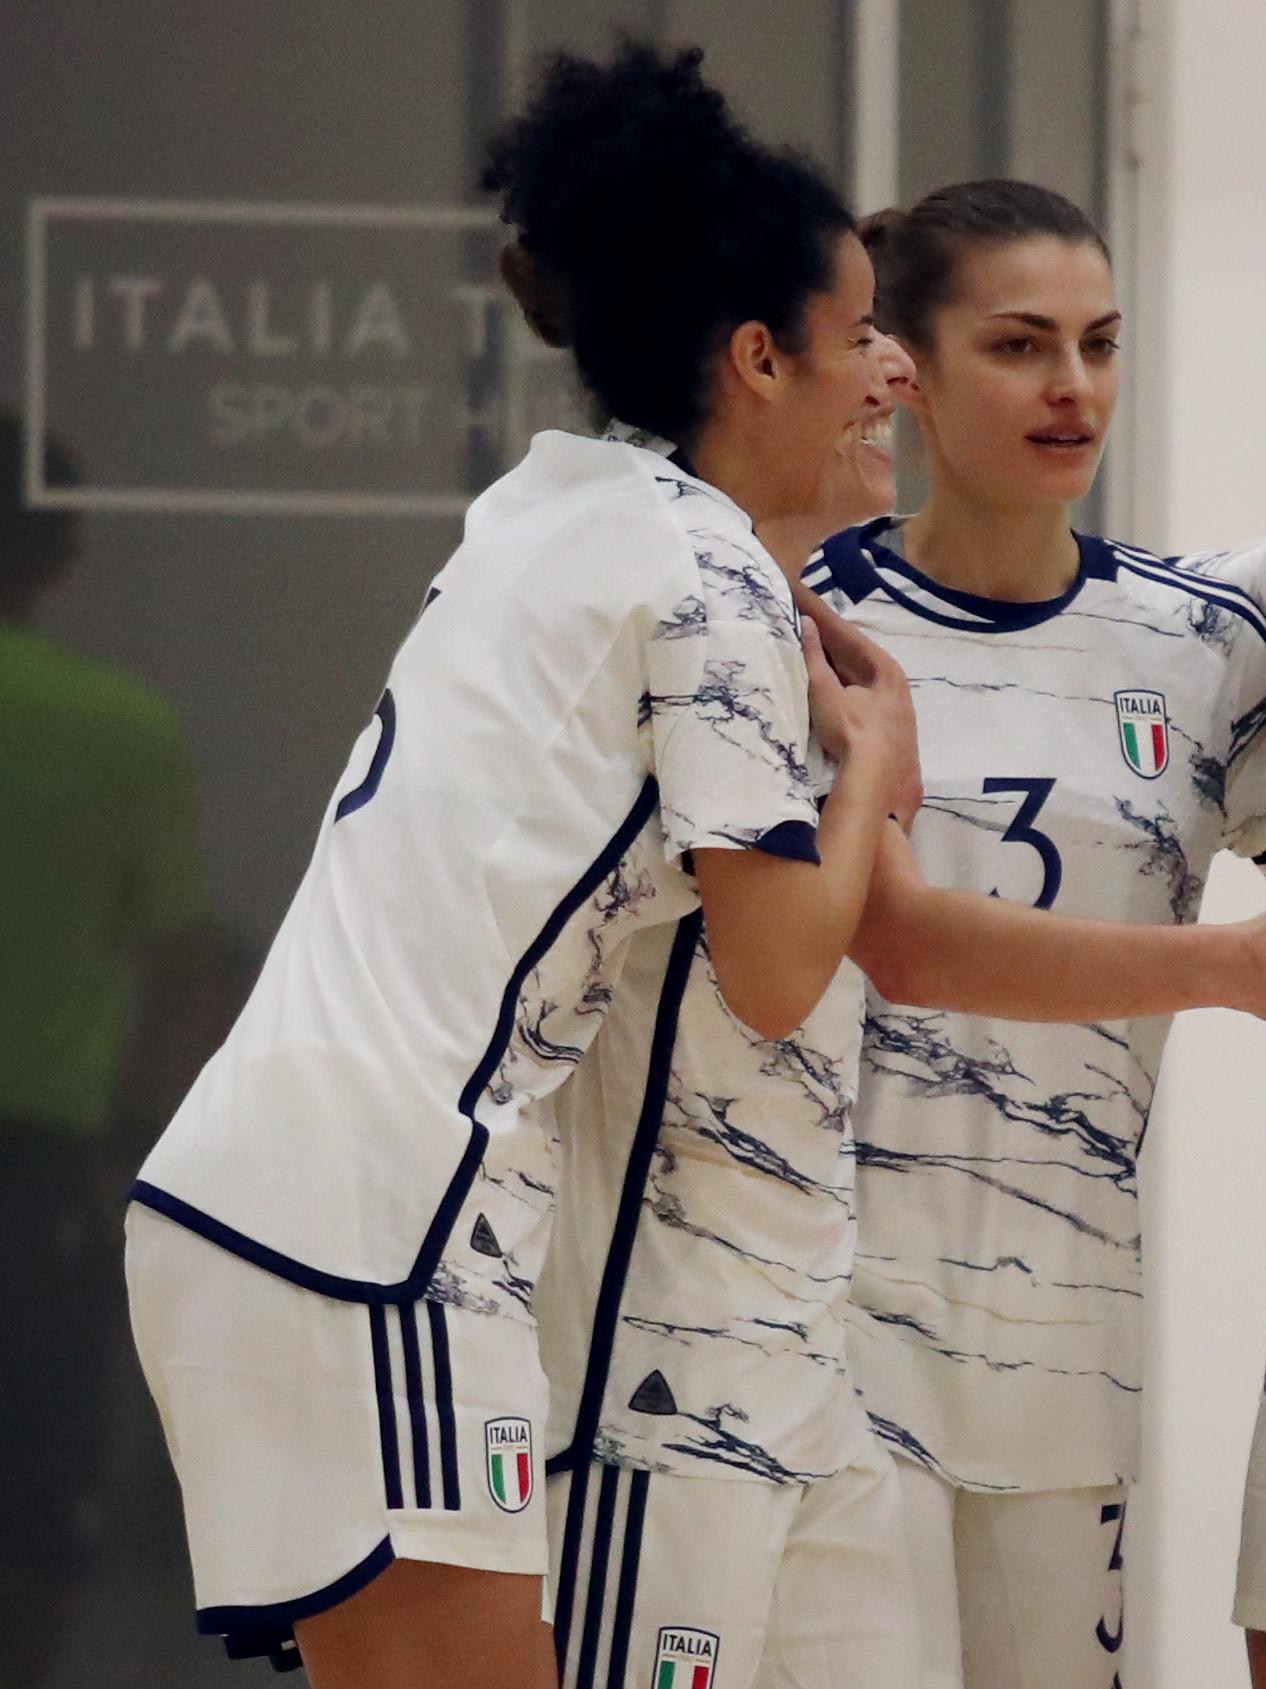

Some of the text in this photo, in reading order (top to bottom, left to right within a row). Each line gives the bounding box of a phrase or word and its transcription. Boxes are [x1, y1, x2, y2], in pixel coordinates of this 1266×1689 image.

[73, 273, 412, 355] ITALIA
[208, 382, 431, 446] SPORT
[1119, 697, 1163, 715] ITALIA
[982, 777, 1063, 911] 3
[489, 1426, 529, 1444] ITALIA
[662, 1633, 712, 1657] ITALIA
